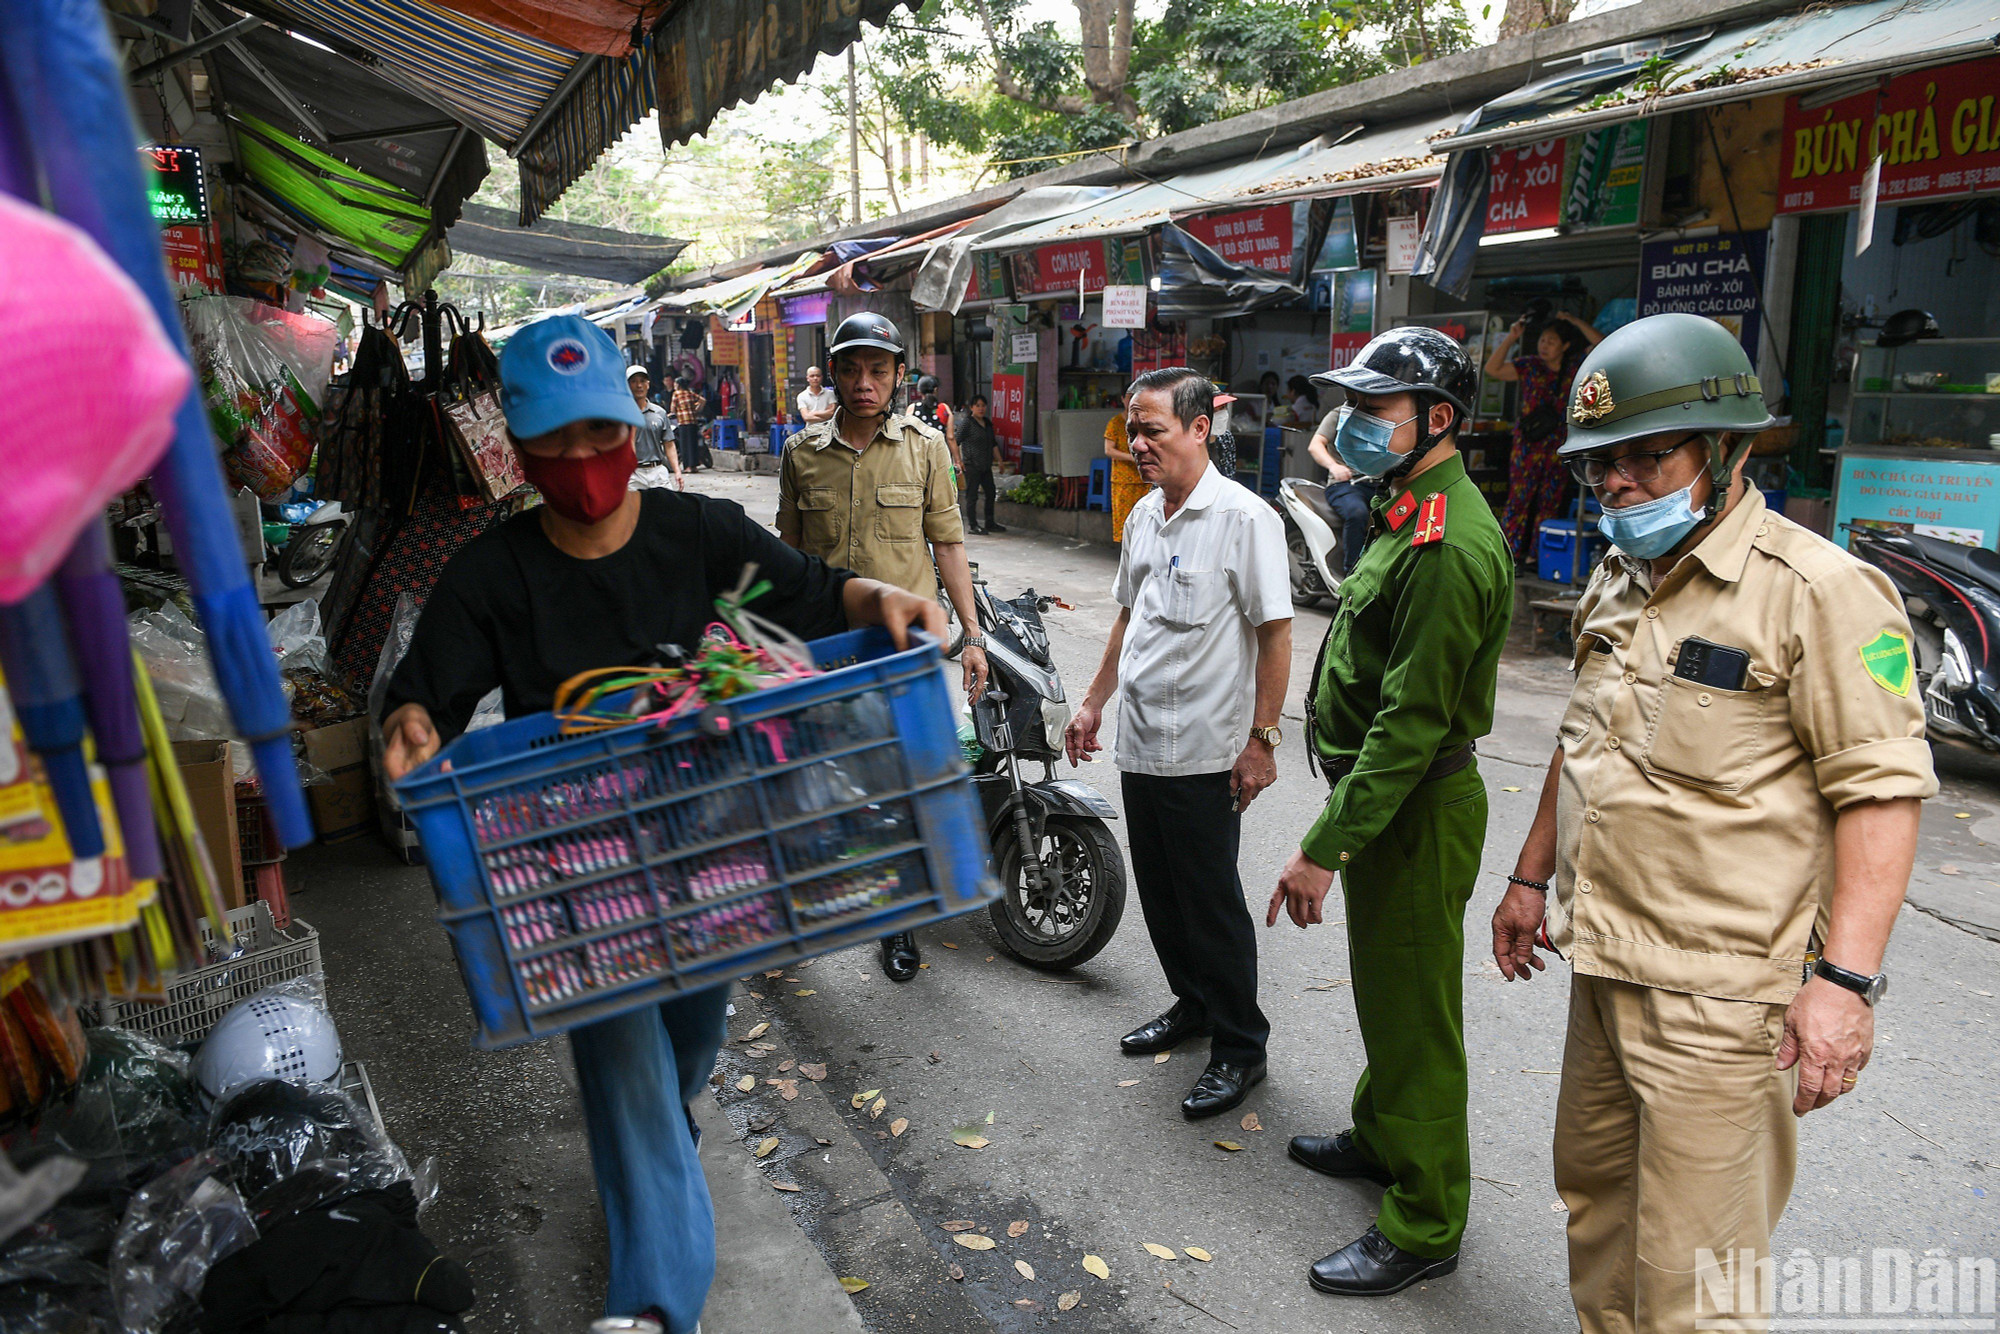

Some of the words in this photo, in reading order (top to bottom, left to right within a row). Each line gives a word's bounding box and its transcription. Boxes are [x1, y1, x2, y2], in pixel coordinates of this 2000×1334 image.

[1791, 108, 1862, 179] BÚN
[1869, 82, 1940, 166] CHẢ
[1523, 161, 1557, 188] XÔI
[1489, 192, 1528, 222] CHẢ
[1214, 221, 1232, 238] BÚN
[1233, 217, 1246, 235] BÒ
[1246, 214, 1265, 233] HUẾ
[1224, 239, 1236, 255] BÒ
[1237, 236, 1254, 254] SỐT
[1255, 235, 1280, 252] VANG
[1652, 261, 1697, 280] BÚN
[1703, 253, 1750, 275] CHẢ
[1657, 282, 1690, 298] BÁNH
[1693, 280, 1712, 295] MỲ
[1721, 278, 1743, 294] XÔI
[1662, 298, 1696, 314] UỐNG
[1699, 296, 1724, 313] CÁC
[1727, 298, 1756, 313] LOẠI
[1010, 387, 1021, 402] BÒ
[1853, 470, 1877, 480] BÚN
[1911, 474, 1933, 484] GIA
[1889, 505, 1912, 518] các
[1915, 506, 1942, 522] loại
